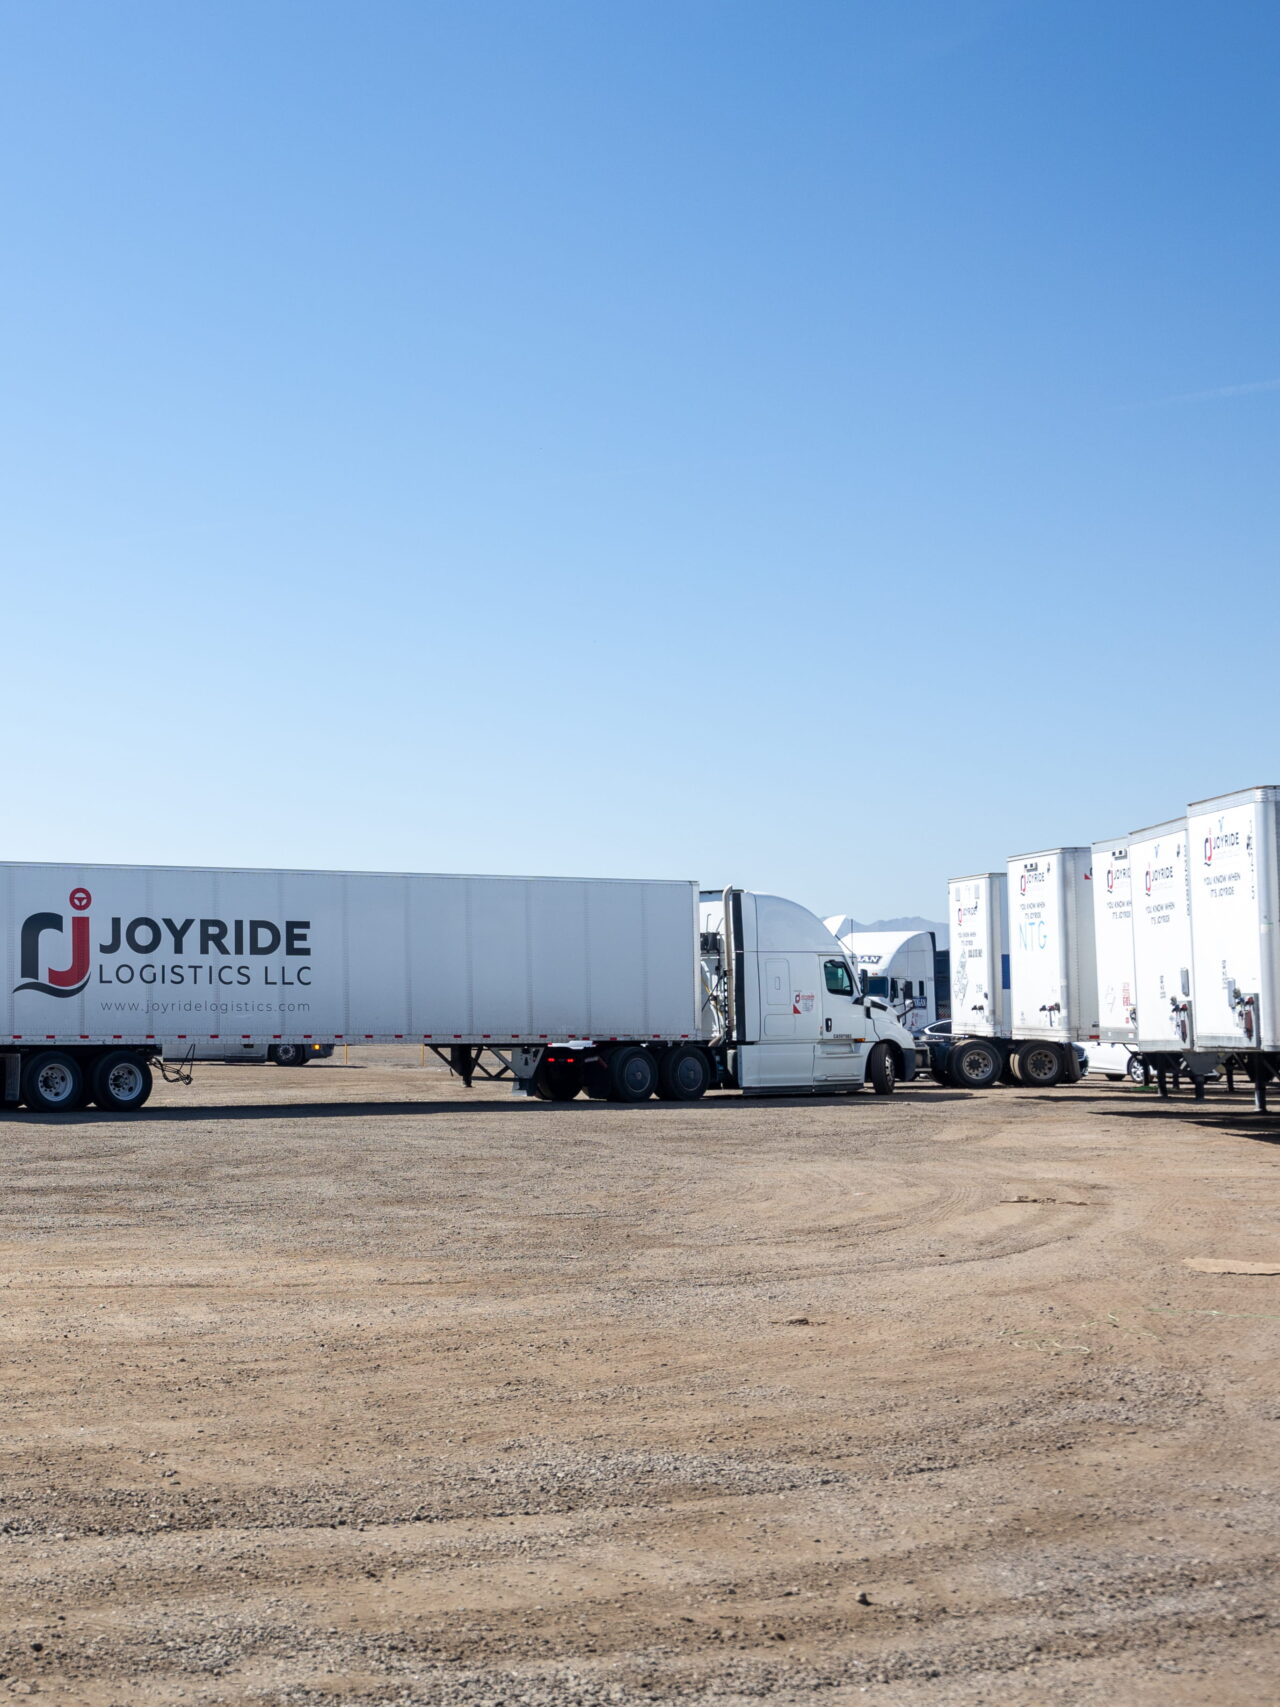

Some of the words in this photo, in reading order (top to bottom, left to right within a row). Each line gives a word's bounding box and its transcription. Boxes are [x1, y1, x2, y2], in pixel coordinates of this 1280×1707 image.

[1213, 832, 1240, 850] JOYRIDE
[1151, 866, 1173, 882] JOYRIDE
[99, 917, 312, 957] JOYRIDE
[1019, 921, 1047, 951] NTG
[99, 964, 251, 986] LOGISTICS
[264, 966, 312, 986] LLC
[101, 1001, 311, 1015] www.joyridelogistics.com
